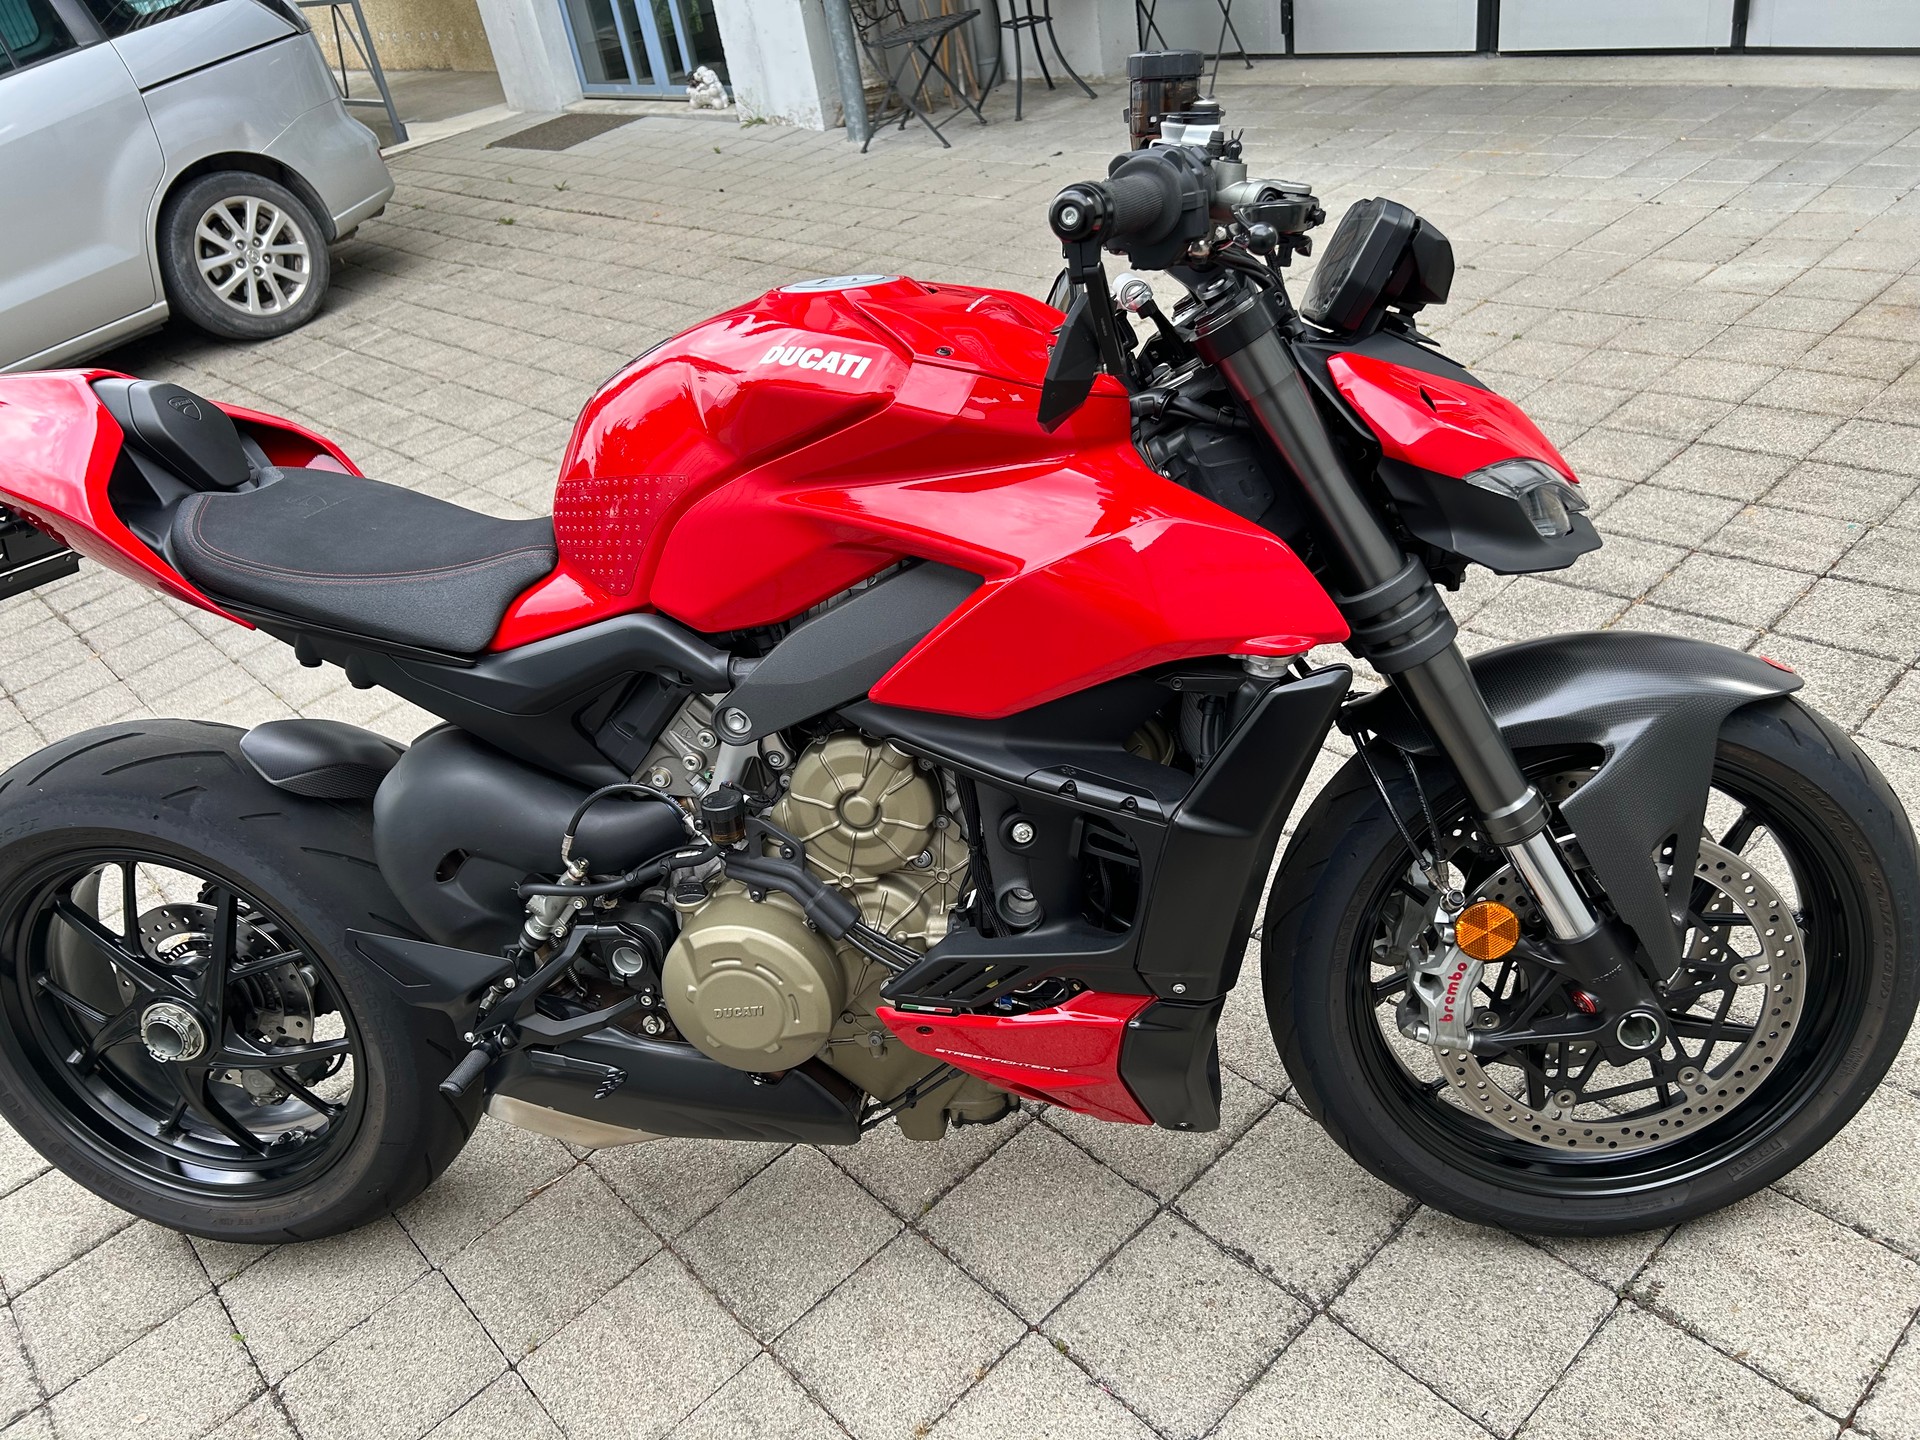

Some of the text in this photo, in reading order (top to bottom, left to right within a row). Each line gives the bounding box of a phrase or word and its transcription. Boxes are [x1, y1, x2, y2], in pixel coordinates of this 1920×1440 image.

[759, 346, 872, 379] DUCATI
[1439, 962, 1468, 1023] brembo
[713, 1005, 764, 1020] DUCATI
[935, 1048, 1051, 1071] STREETFIGHTER
